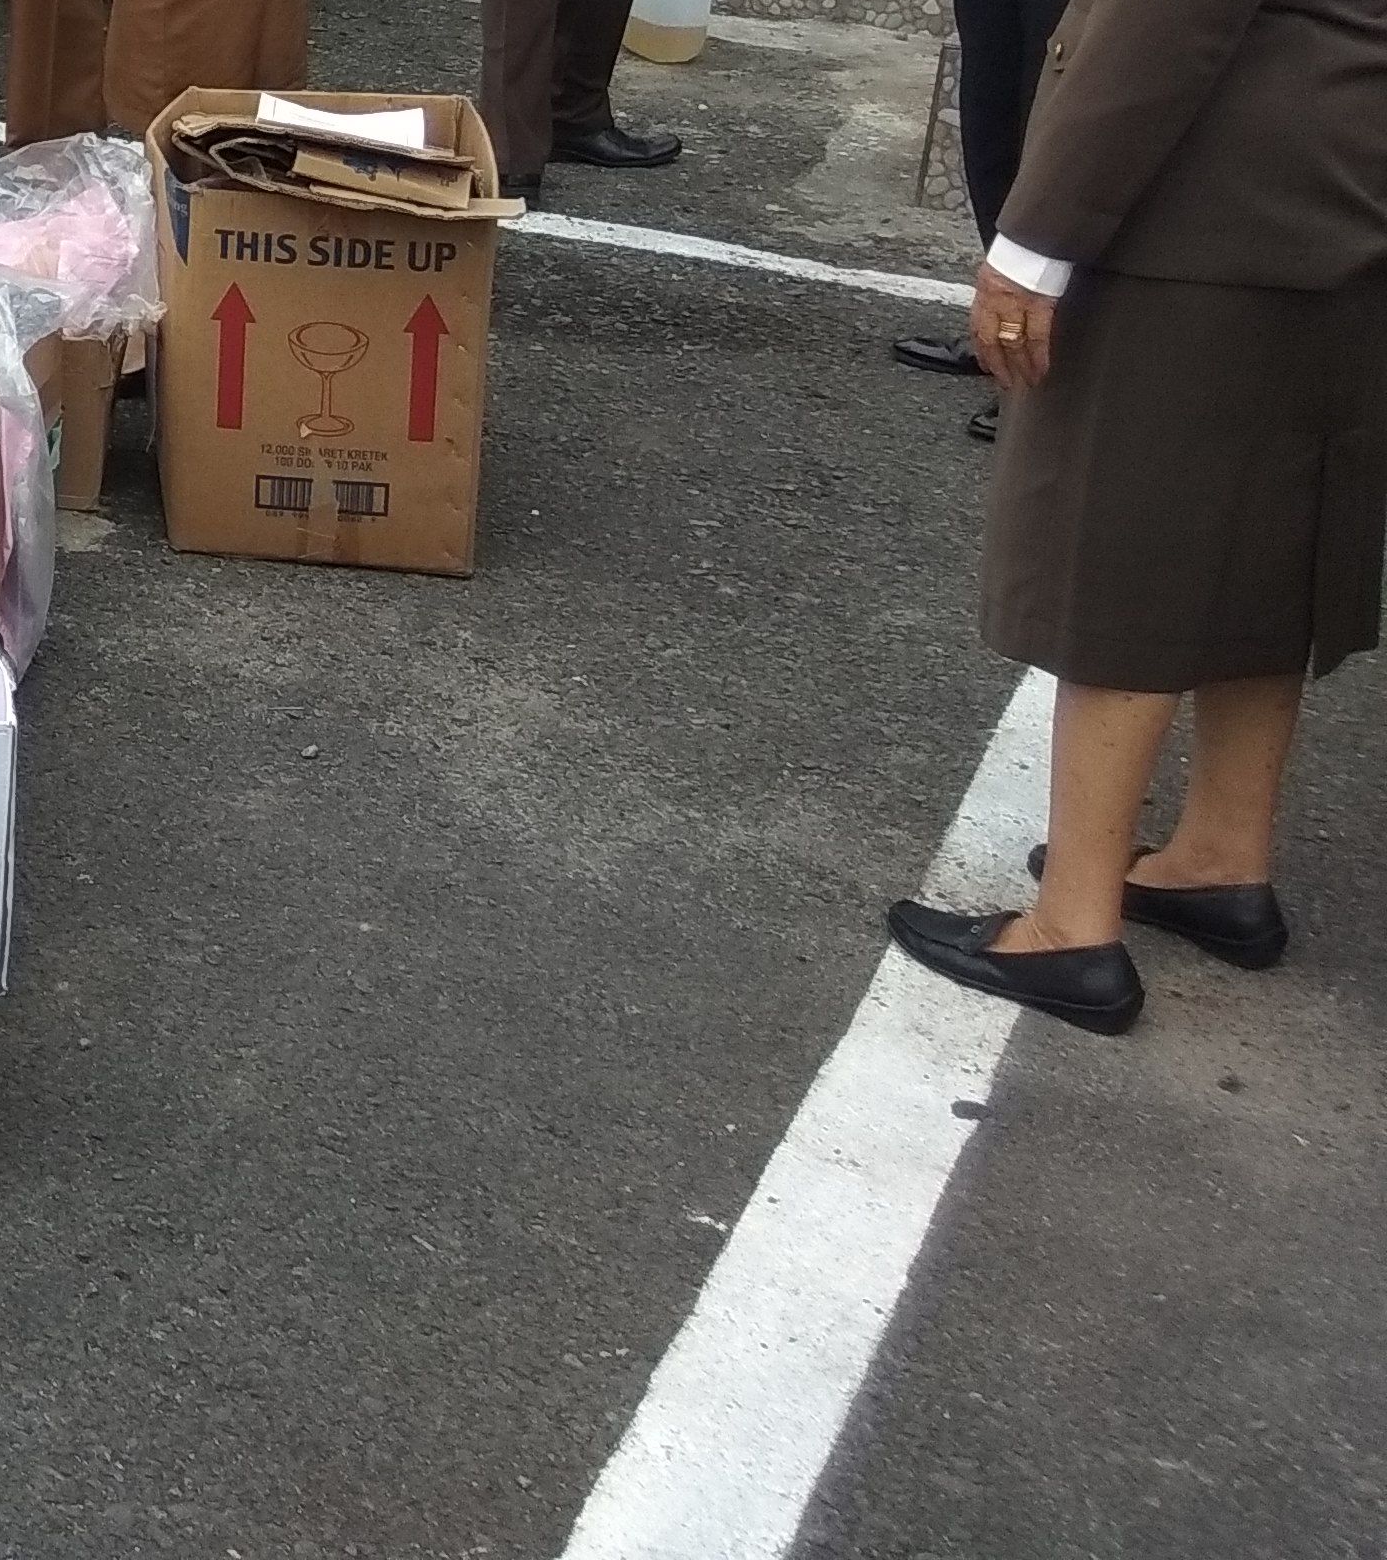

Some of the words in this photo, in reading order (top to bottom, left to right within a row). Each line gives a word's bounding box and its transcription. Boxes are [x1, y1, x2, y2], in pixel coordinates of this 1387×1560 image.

[214, 228, 297, 265] THIS
[307, 233, 395, 271] SIDE
[407, 241, 457, 273] UP
[347, 449, 388, 462] KRETEK
[297, 457, 315, 469] DO
[351, 461, 373, 472] PAK
